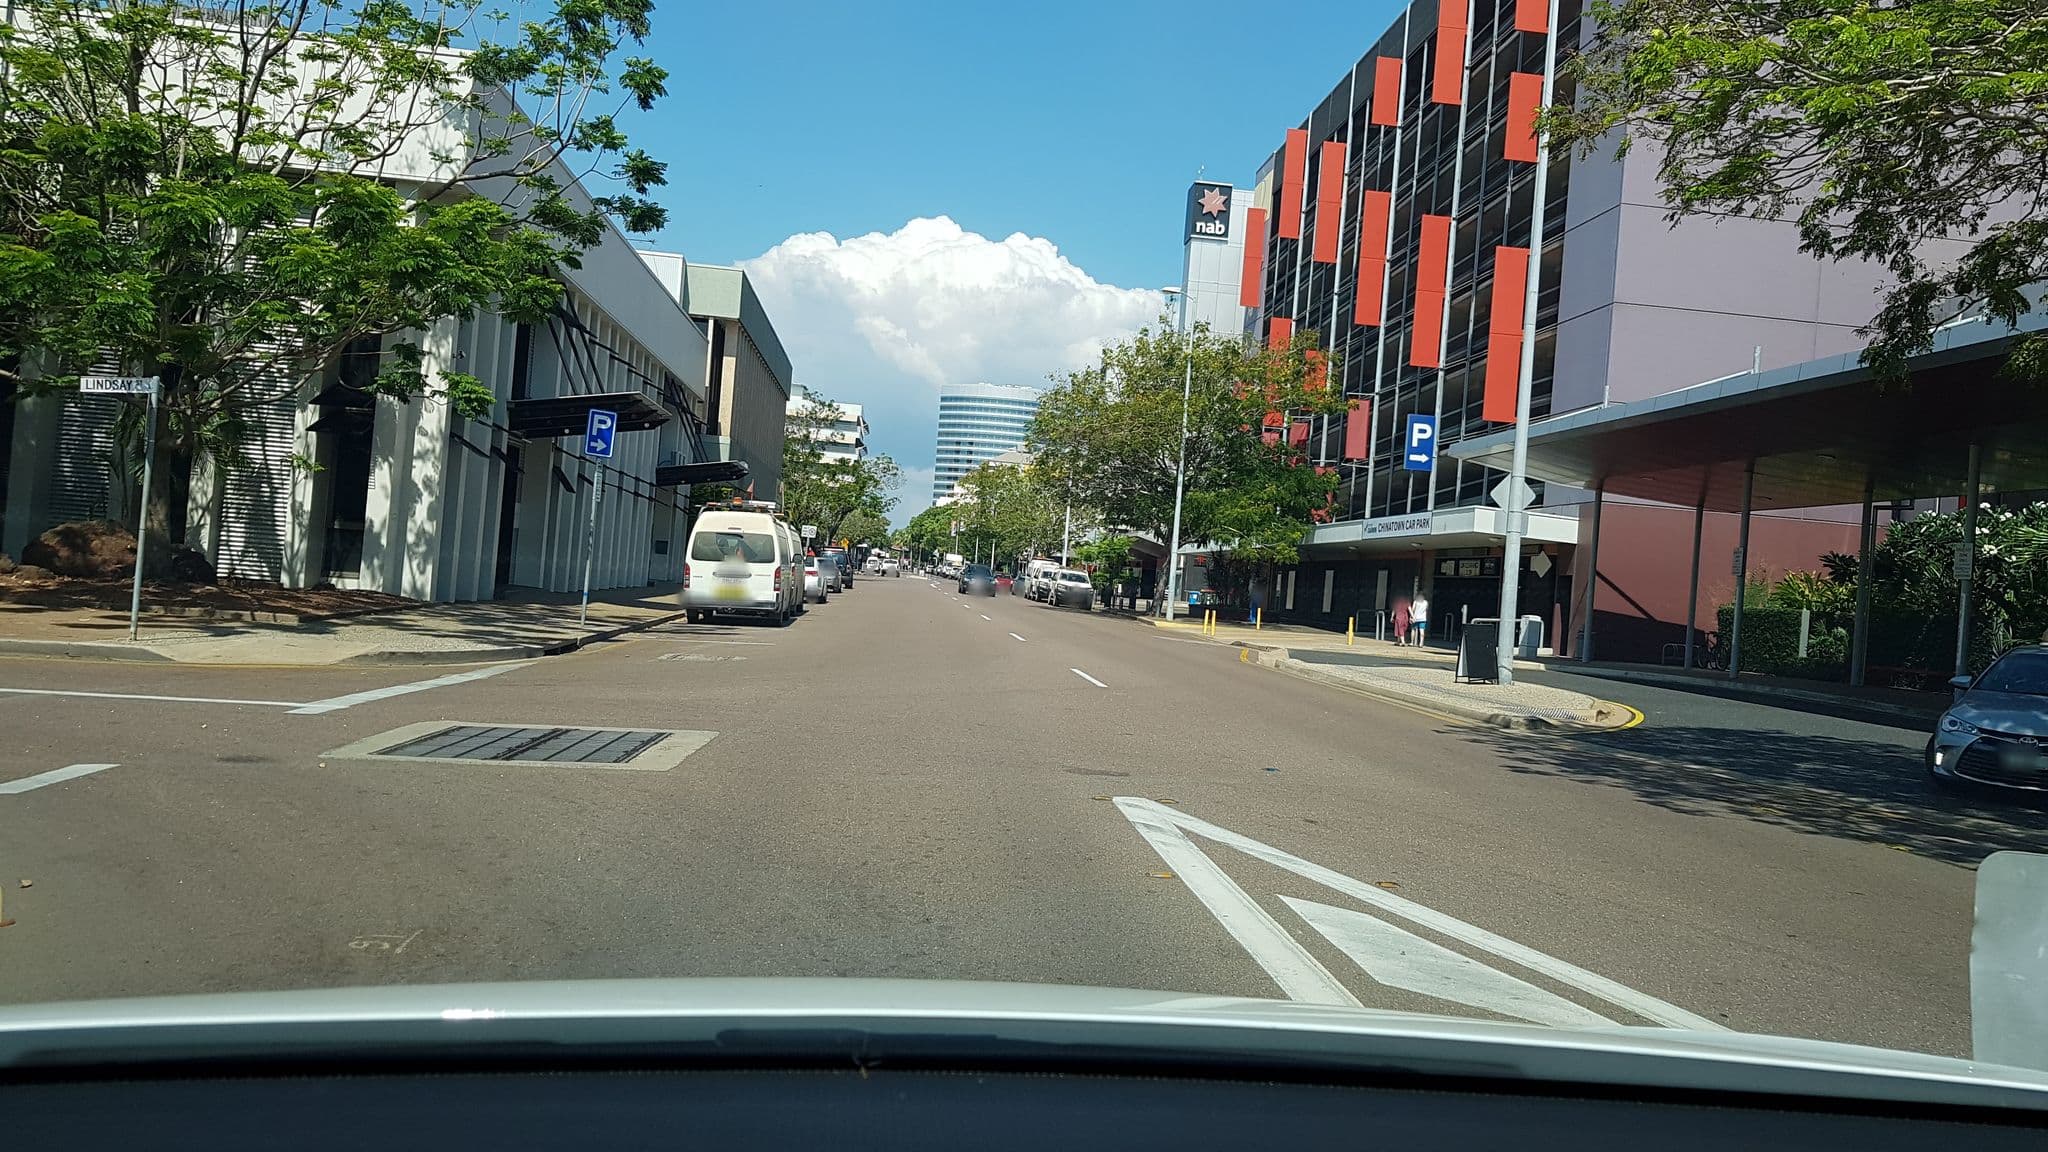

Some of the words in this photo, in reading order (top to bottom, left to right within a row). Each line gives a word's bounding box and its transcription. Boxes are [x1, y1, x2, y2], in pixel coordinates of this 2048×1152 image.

[1195, 220, 1225, 235] nab
[85, 379, 132, 391] LINDSAY
[592, 414, 611, 436] P
[1411, 422, 1432, 447] P
[1378, 521, 1405, 533] CHINATOWN
[1406, 519, 1416, 530] CAR
[1417, 517, 1430, 529] PARK
